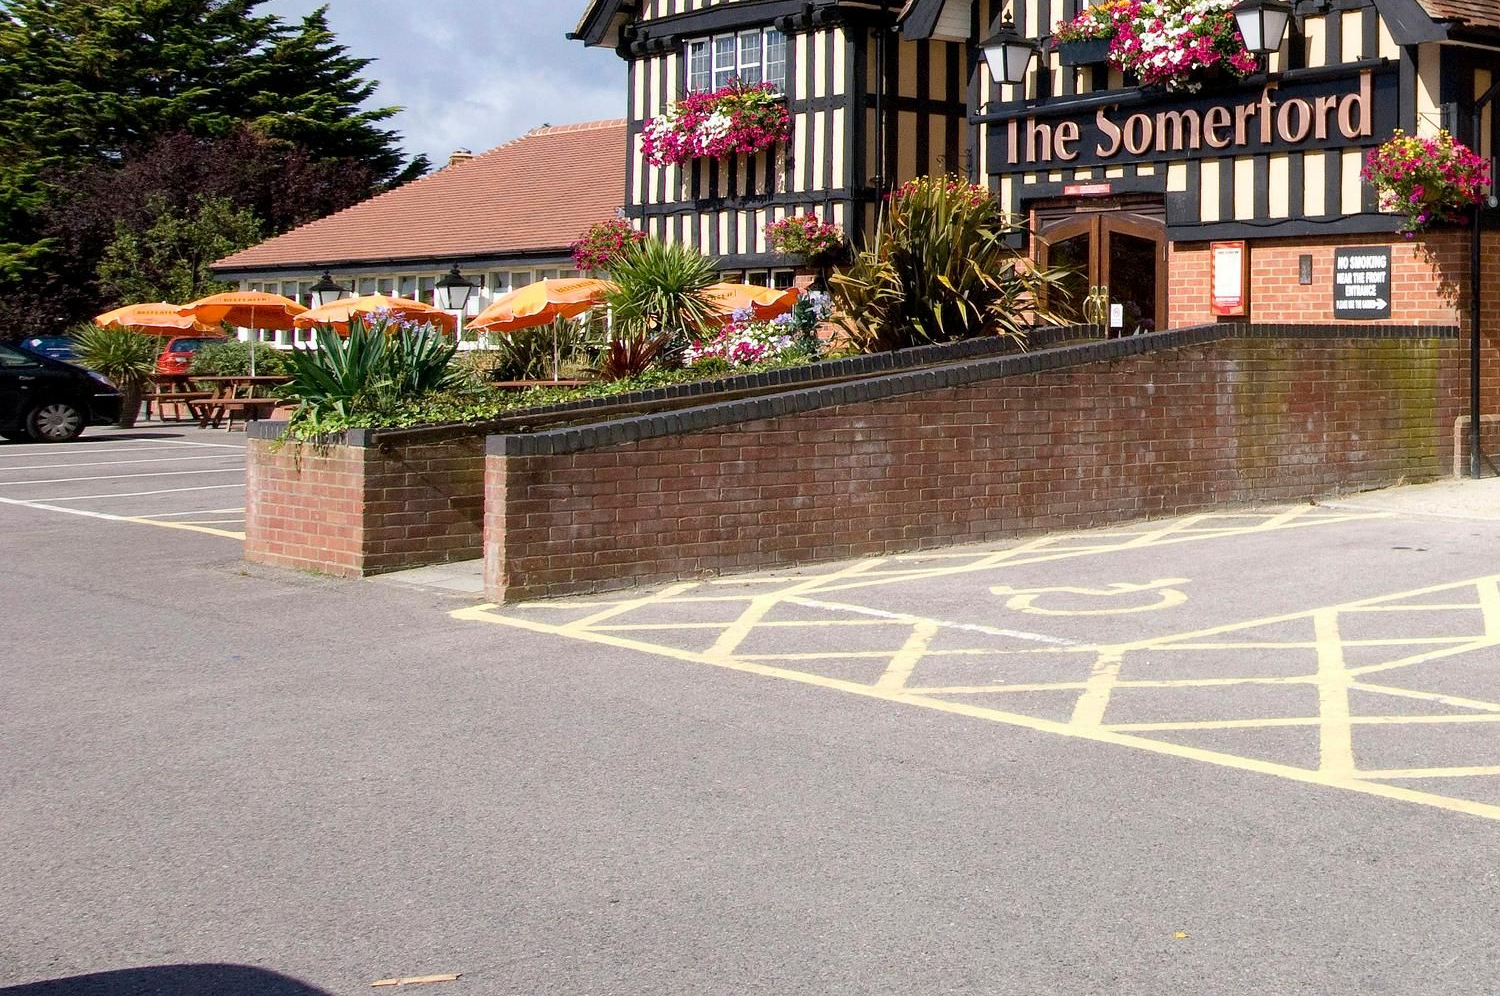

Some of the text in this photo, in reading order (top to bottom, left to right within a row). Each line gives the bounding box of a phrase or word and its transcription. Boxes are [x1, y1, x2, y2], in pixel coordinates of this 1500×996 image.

[1007, 69, 1373, 164] The Somerford
[1337, 255, 1387, 269] NO SMOKING
[1336, 271, 1386, 284] NEAR THE FRONT
[1345, 284, 1377, 296] ENTRANCE
